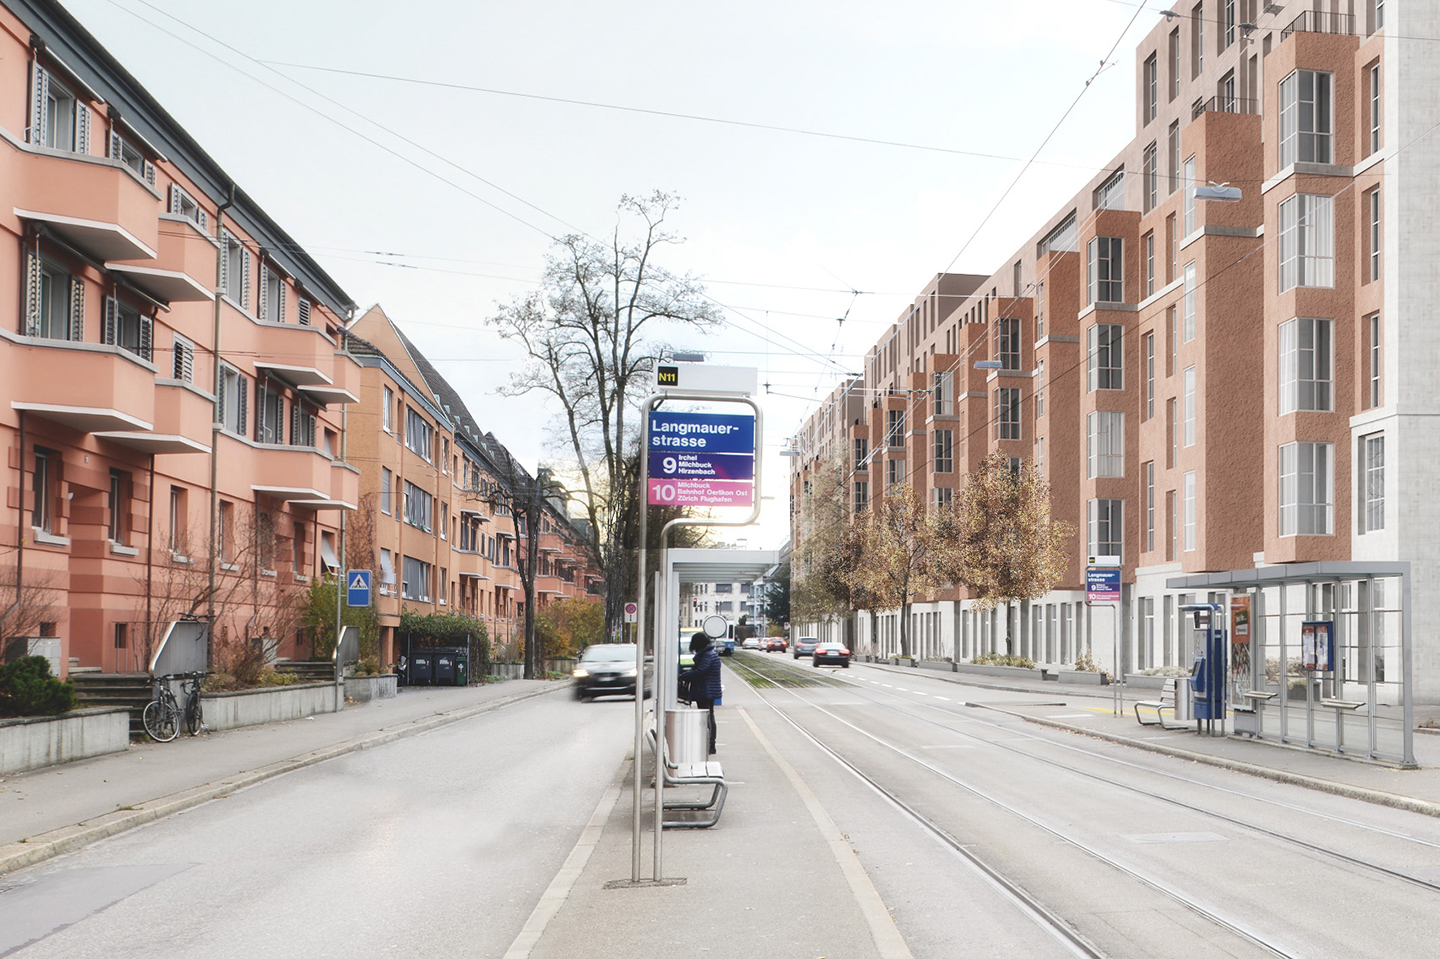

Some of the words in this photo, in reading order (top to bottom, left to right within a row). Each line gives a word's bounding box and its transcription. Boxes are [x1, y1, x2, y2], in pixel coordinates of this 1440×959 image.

[658, 372, 676, 382] N11
[652, 419, 739, 435] Langmauer-
[652, 434, 707, 448] strasse
[662, 457, 677, 474] 9
[652, 484, 676, 501] 10
[677, 481, 710, 489] Milchbuck
